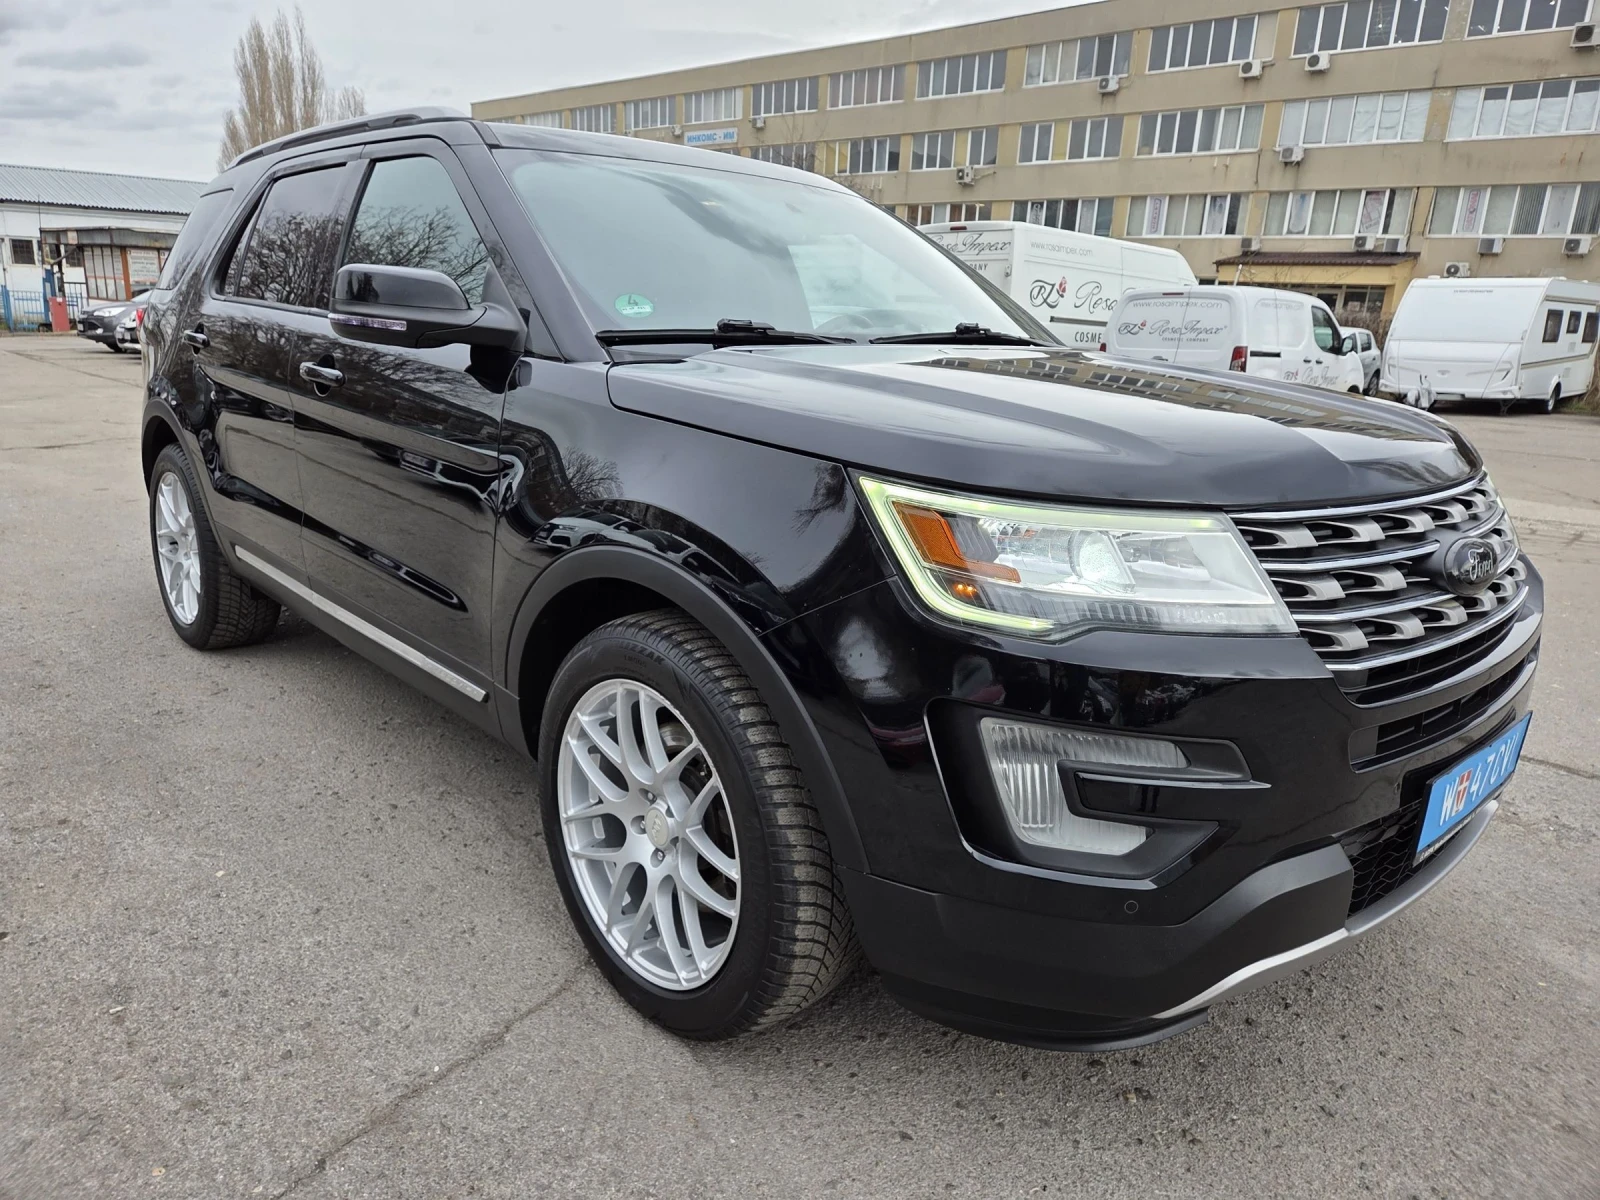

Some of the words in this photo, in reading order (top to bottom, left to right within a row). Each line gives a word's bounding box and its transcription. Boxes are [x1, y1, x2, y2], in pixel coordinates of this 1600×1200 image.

[687, 132, 717, 143] ИНКОМС
[723, 131, 734, 140] ИМ
[1030, 240, 1094, 257] www.rosaimpex.com
[1132, 300, 1223, 309] www.rosaimpex.com
[1074, 331, 1102, 344] COSME
[1467, 547, 1494, 581] Ford
[1439, 776, 1460, 827] W
